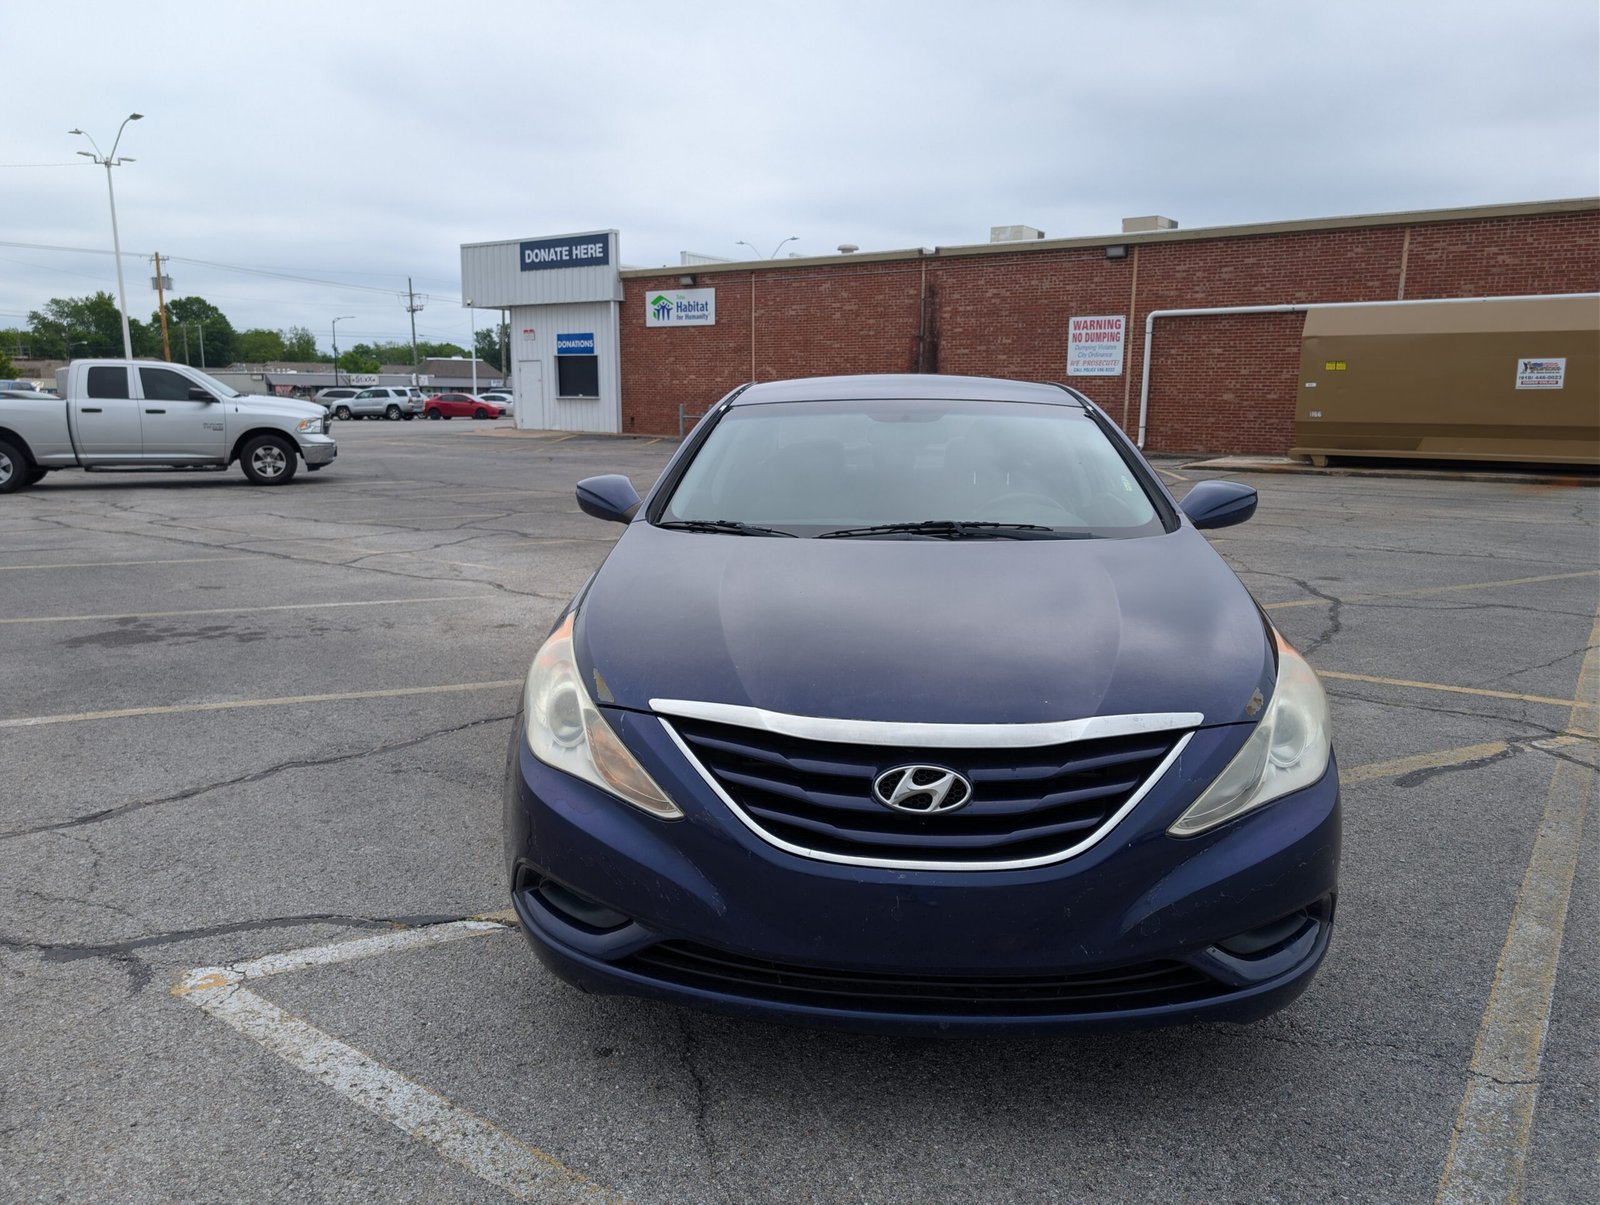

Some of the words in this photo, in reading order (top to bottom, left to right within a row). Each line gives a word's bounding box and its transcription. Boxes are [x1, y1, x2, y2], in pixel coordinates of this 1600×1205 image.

[524, 246, 570, 264] DONATE
[572, 243, 604, 260] HERE
[676, 301, 709, 313] Habitat
[1073, 319, 1121, 330] WARNING
[1072, 332, 1083, 343] NO
[1085, 331, 1121, 343] DUMPING
[557, 340, 593, 349] DONATIONS
